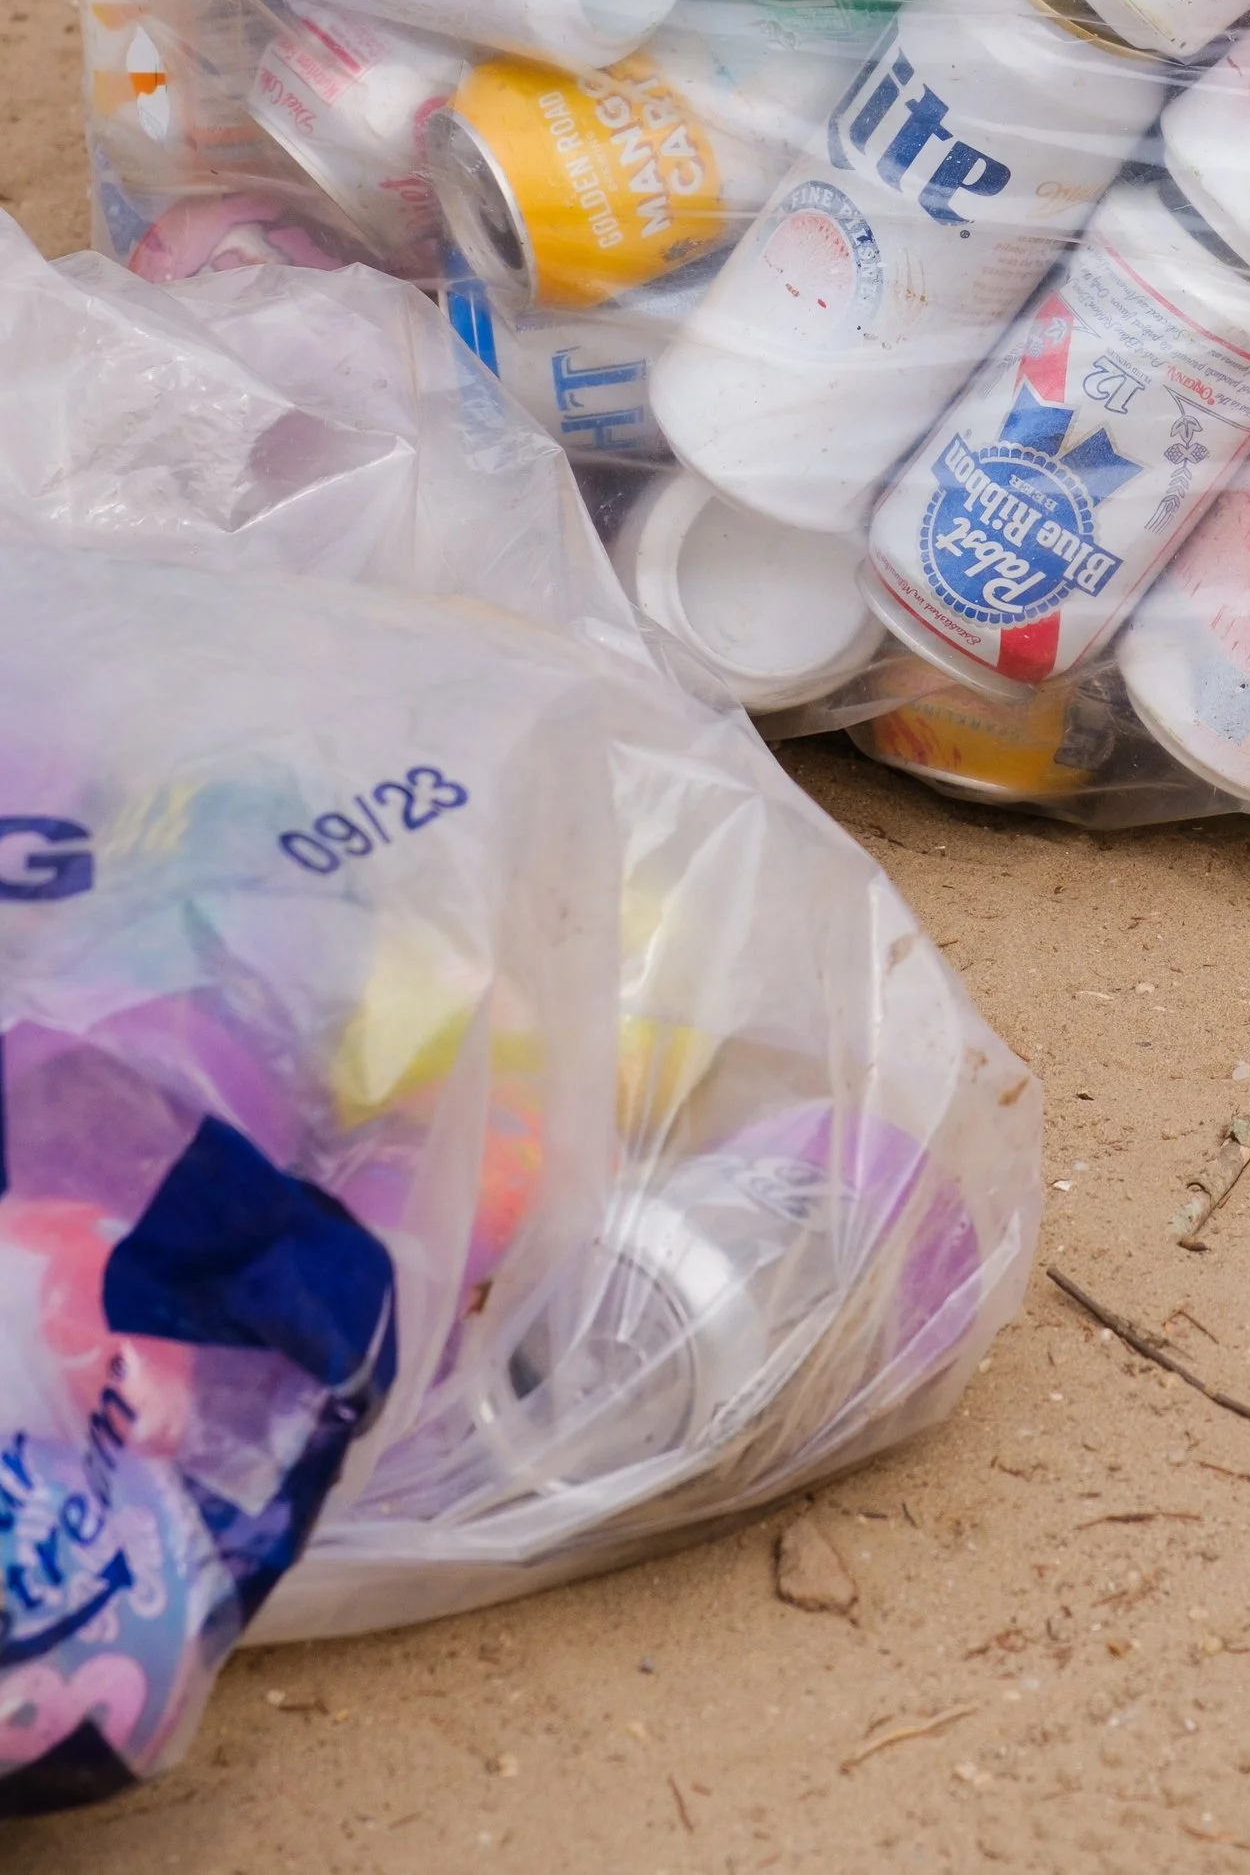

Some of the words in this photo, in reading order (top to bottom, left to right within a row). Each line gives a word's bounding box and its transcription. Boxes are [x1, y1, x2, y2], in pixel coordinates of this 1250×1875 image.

[540, 91, 581, 152] ROAD
[577, 75, 671, 237] MANGO
[827, 50, 1011, 226] lite
[565, 156, 624, 248] GOLDEN
[792, 186, 834, 210] FINE
[1083, 355, 1145, 415] 12
[941, 439, 1043, 548] Ribbon
[1006, 472, 1059, 513] BEER
[934, 513, 1047, 613] Pabst
[1034, 517, 1116, 593] Blue
[278, 765, 469, 875] 09/23
